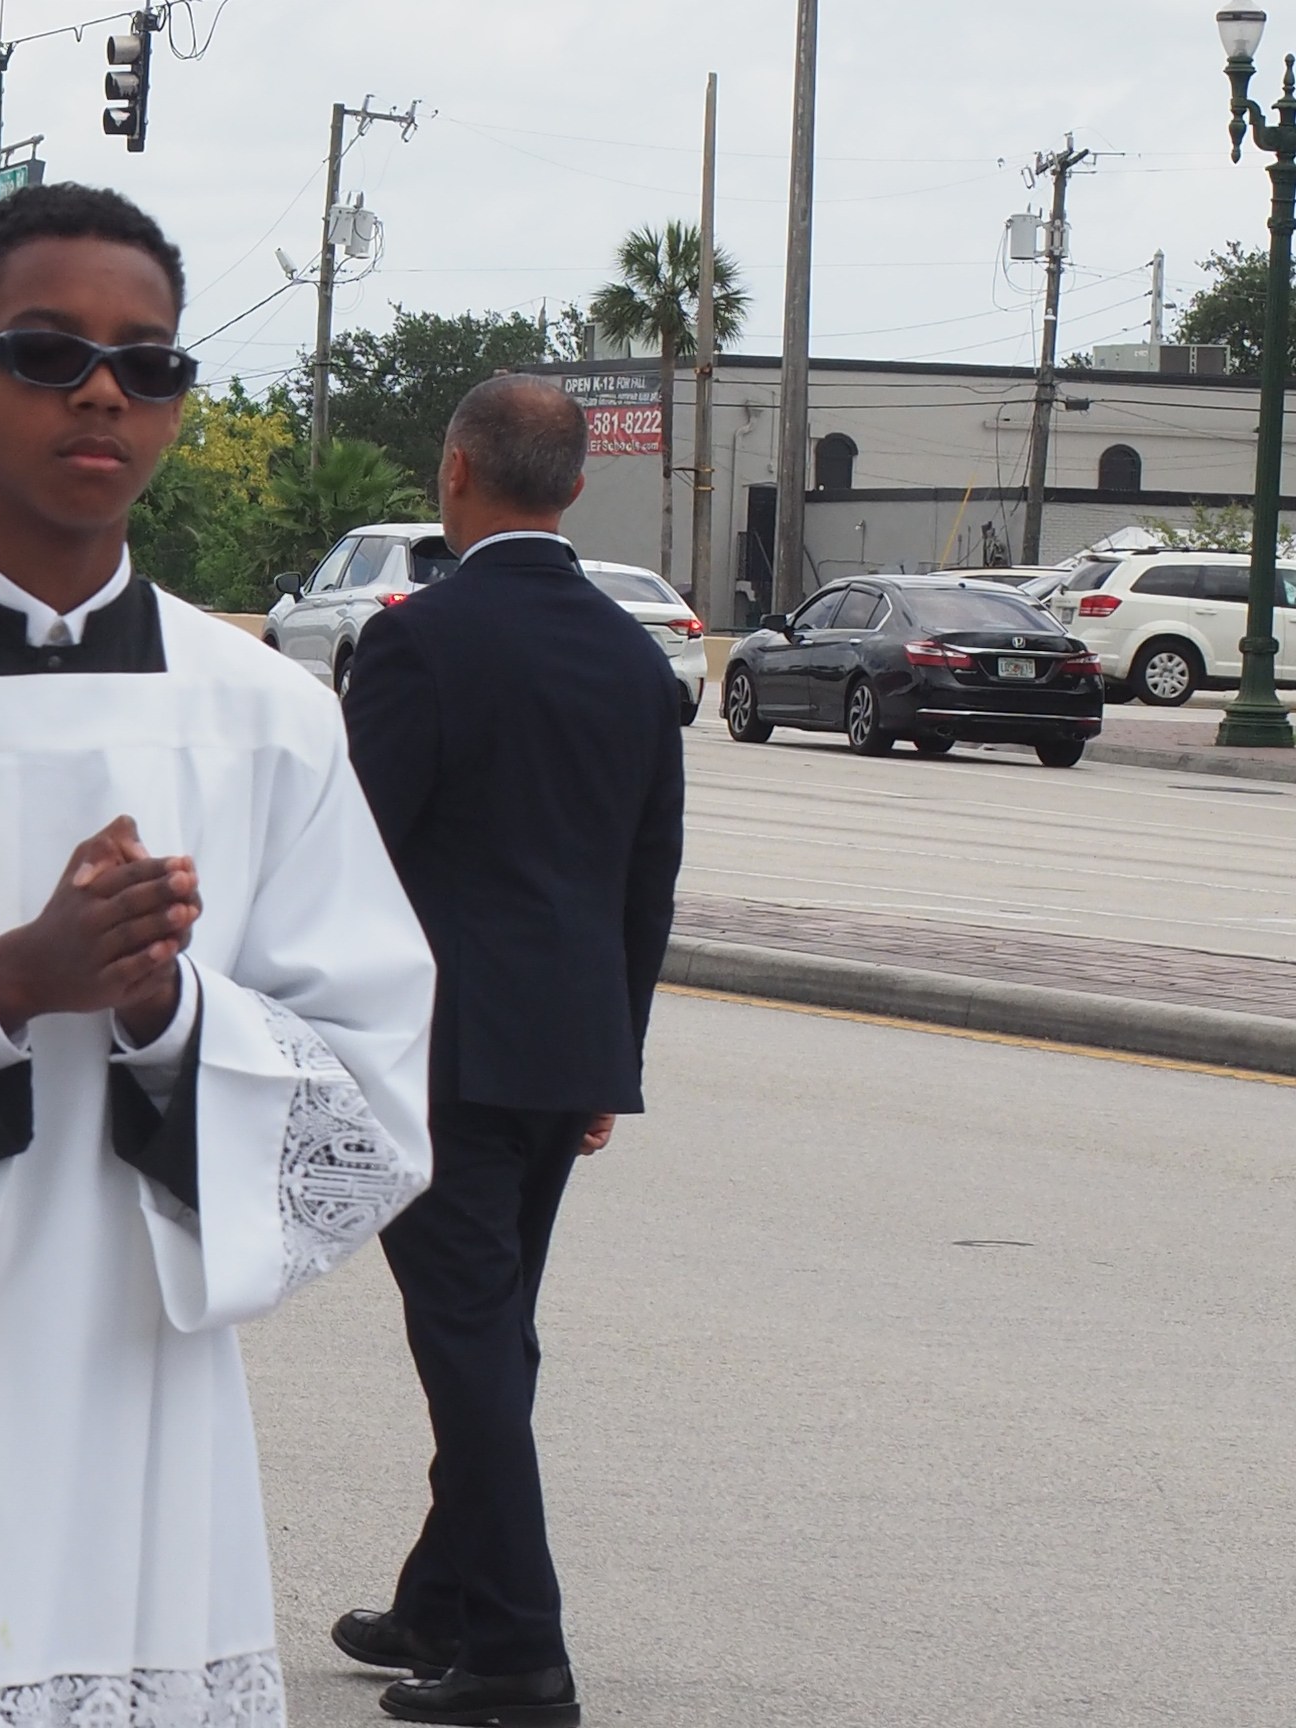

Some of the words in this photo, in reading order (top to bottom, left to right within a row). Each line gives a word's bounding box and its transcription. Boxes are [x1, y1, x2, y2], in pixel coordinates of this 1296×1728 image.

[565, 377, 591, 393] OPEN
[593, 375, 615, 391] K-12
[589, 410, 662, 435] -581-8222
[587, 439, 659, 453] EFSchools.com
